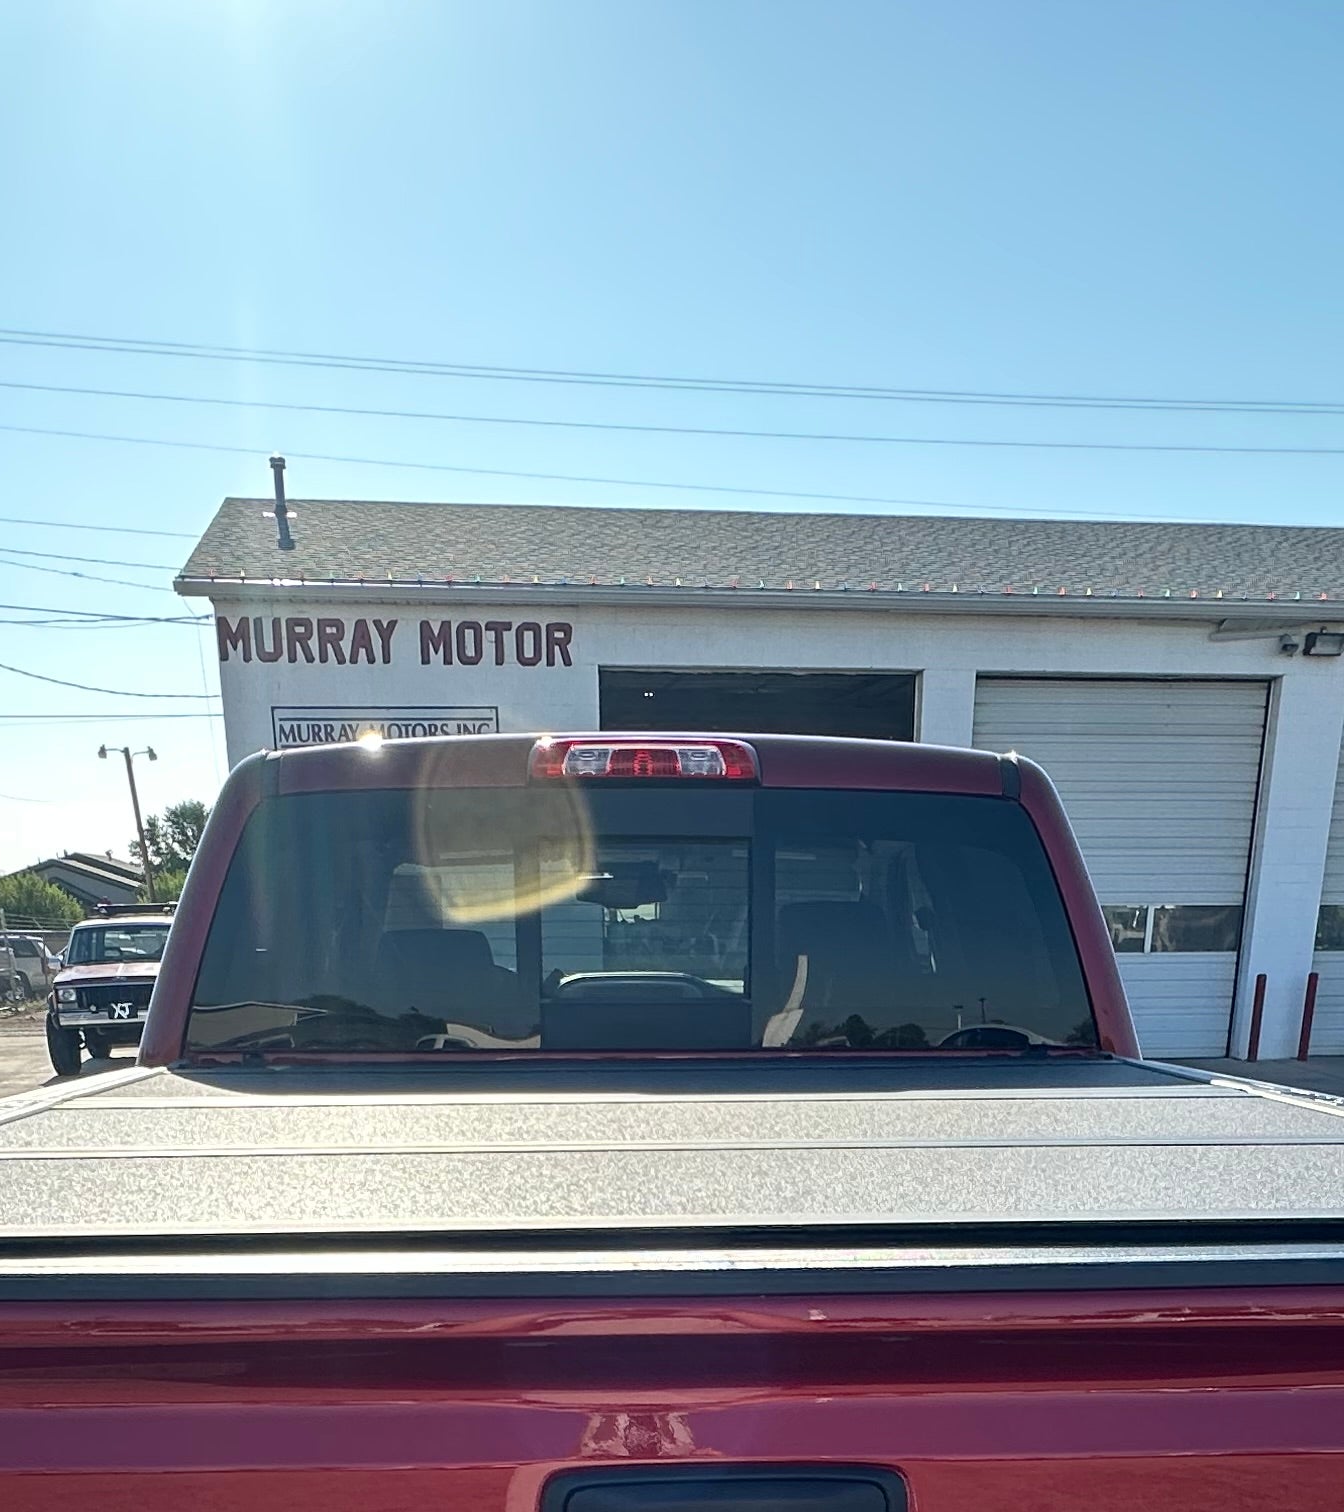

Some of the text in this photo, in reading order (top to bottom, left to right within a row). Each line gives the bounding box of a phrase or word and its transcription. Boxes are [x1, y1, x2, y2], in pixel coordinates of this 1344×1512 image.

[217, 616, 573, 667] MURRAY MOTOR
[279, 722, 360, 743] MURRAY
